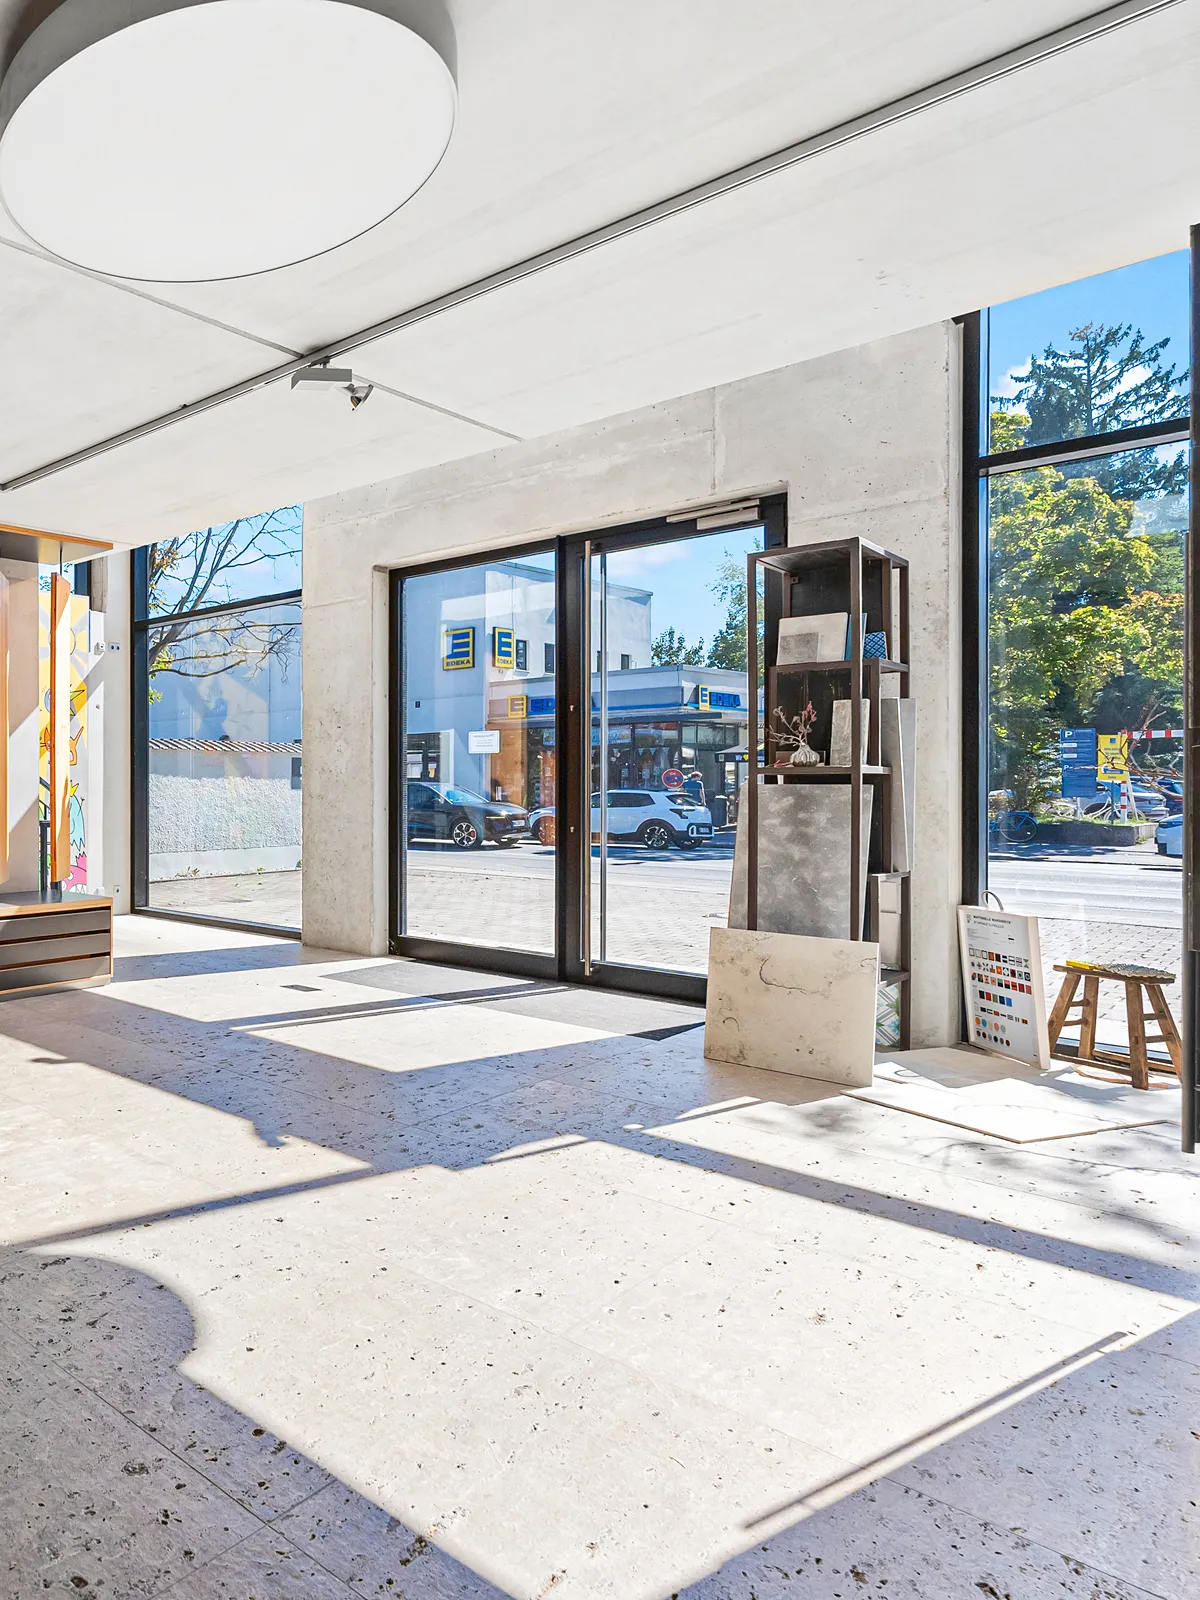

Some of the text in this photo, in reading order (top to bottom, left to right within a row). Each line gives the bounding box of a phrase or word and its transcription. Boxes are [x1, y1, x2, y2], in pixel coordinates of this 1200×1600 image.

[497, 632, 512, 658] E
[446, 659, 471, 667] EDEKA
[700, 687, 709, 704] E
[711, 692, 741, 707] EDEKA
[1064, 730, 1073, 738] P
